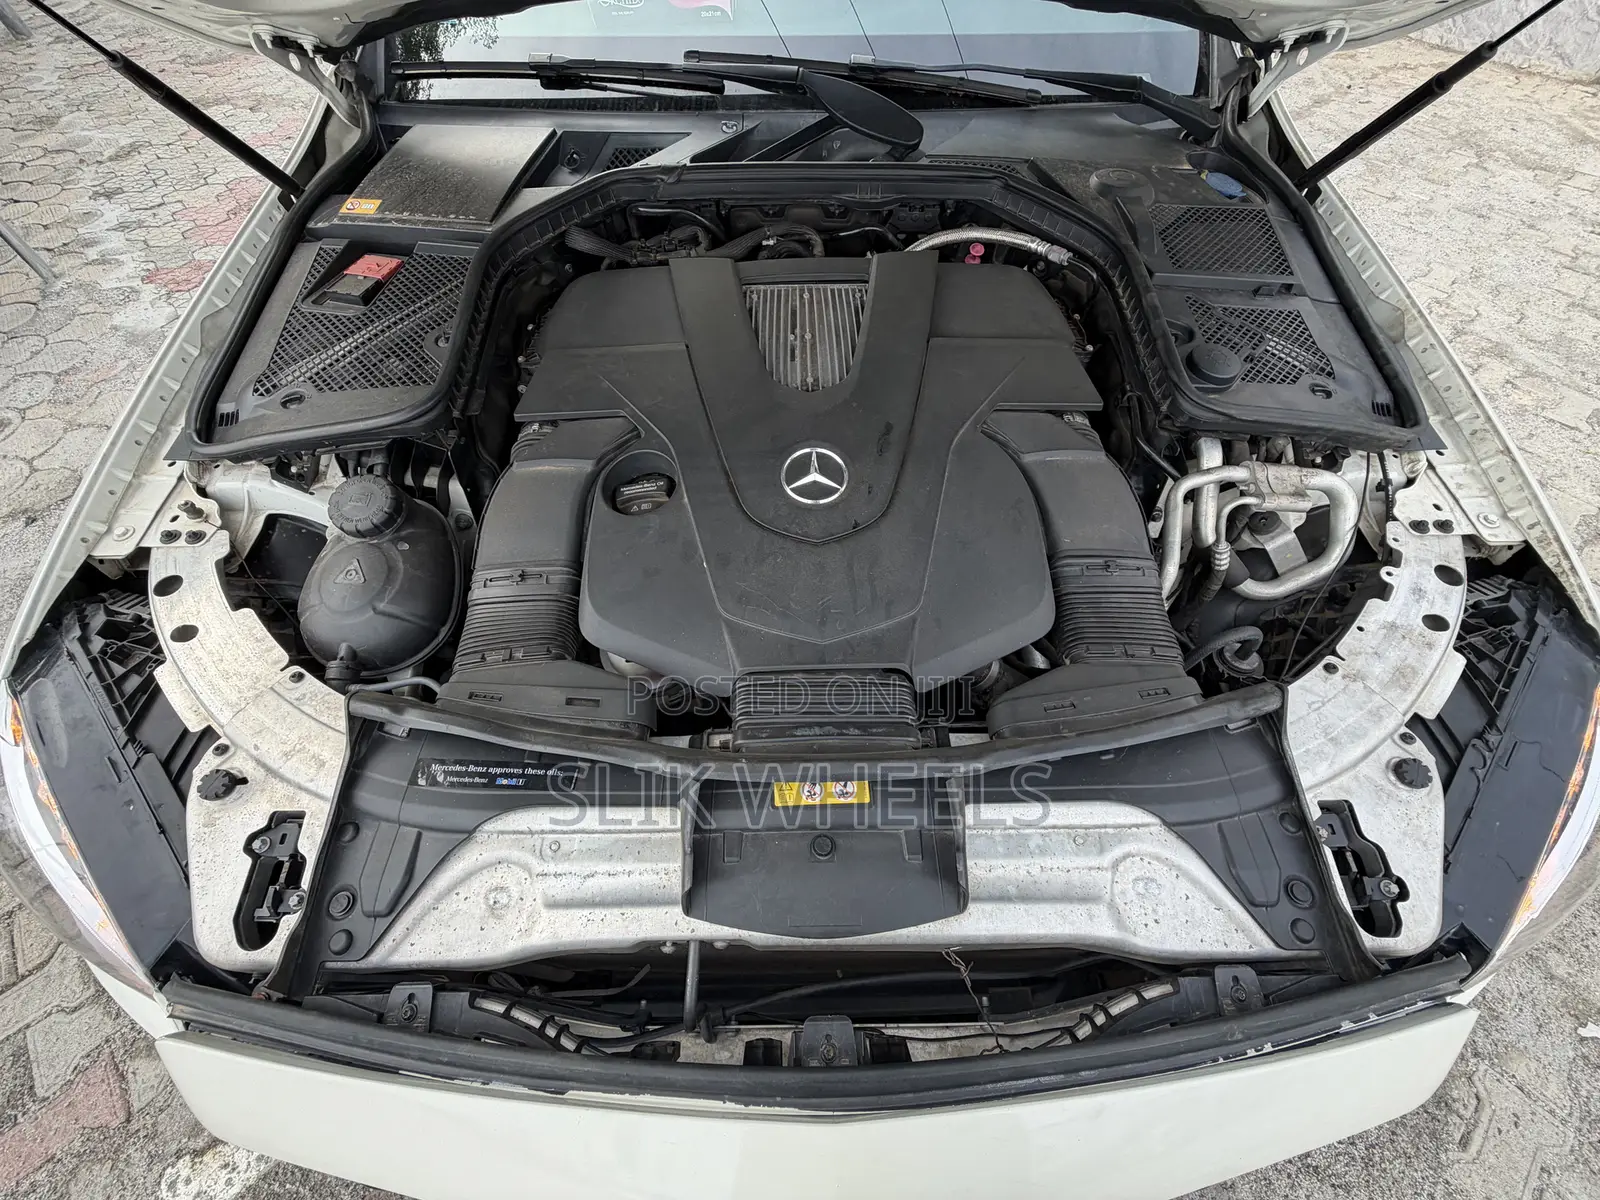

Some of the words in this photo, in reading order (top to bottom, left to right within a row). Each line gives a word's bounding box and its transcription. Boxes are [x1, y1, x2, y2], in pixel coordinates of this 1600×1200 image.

[430, 763, 487, 772] Mercedes-Benz
[488, 767, 523, 775] approves
[524, 767, 545, 775] these
[446, 776, 488, 784] Mercedes-Benz
[495, 777, 517, 785] Mobil
